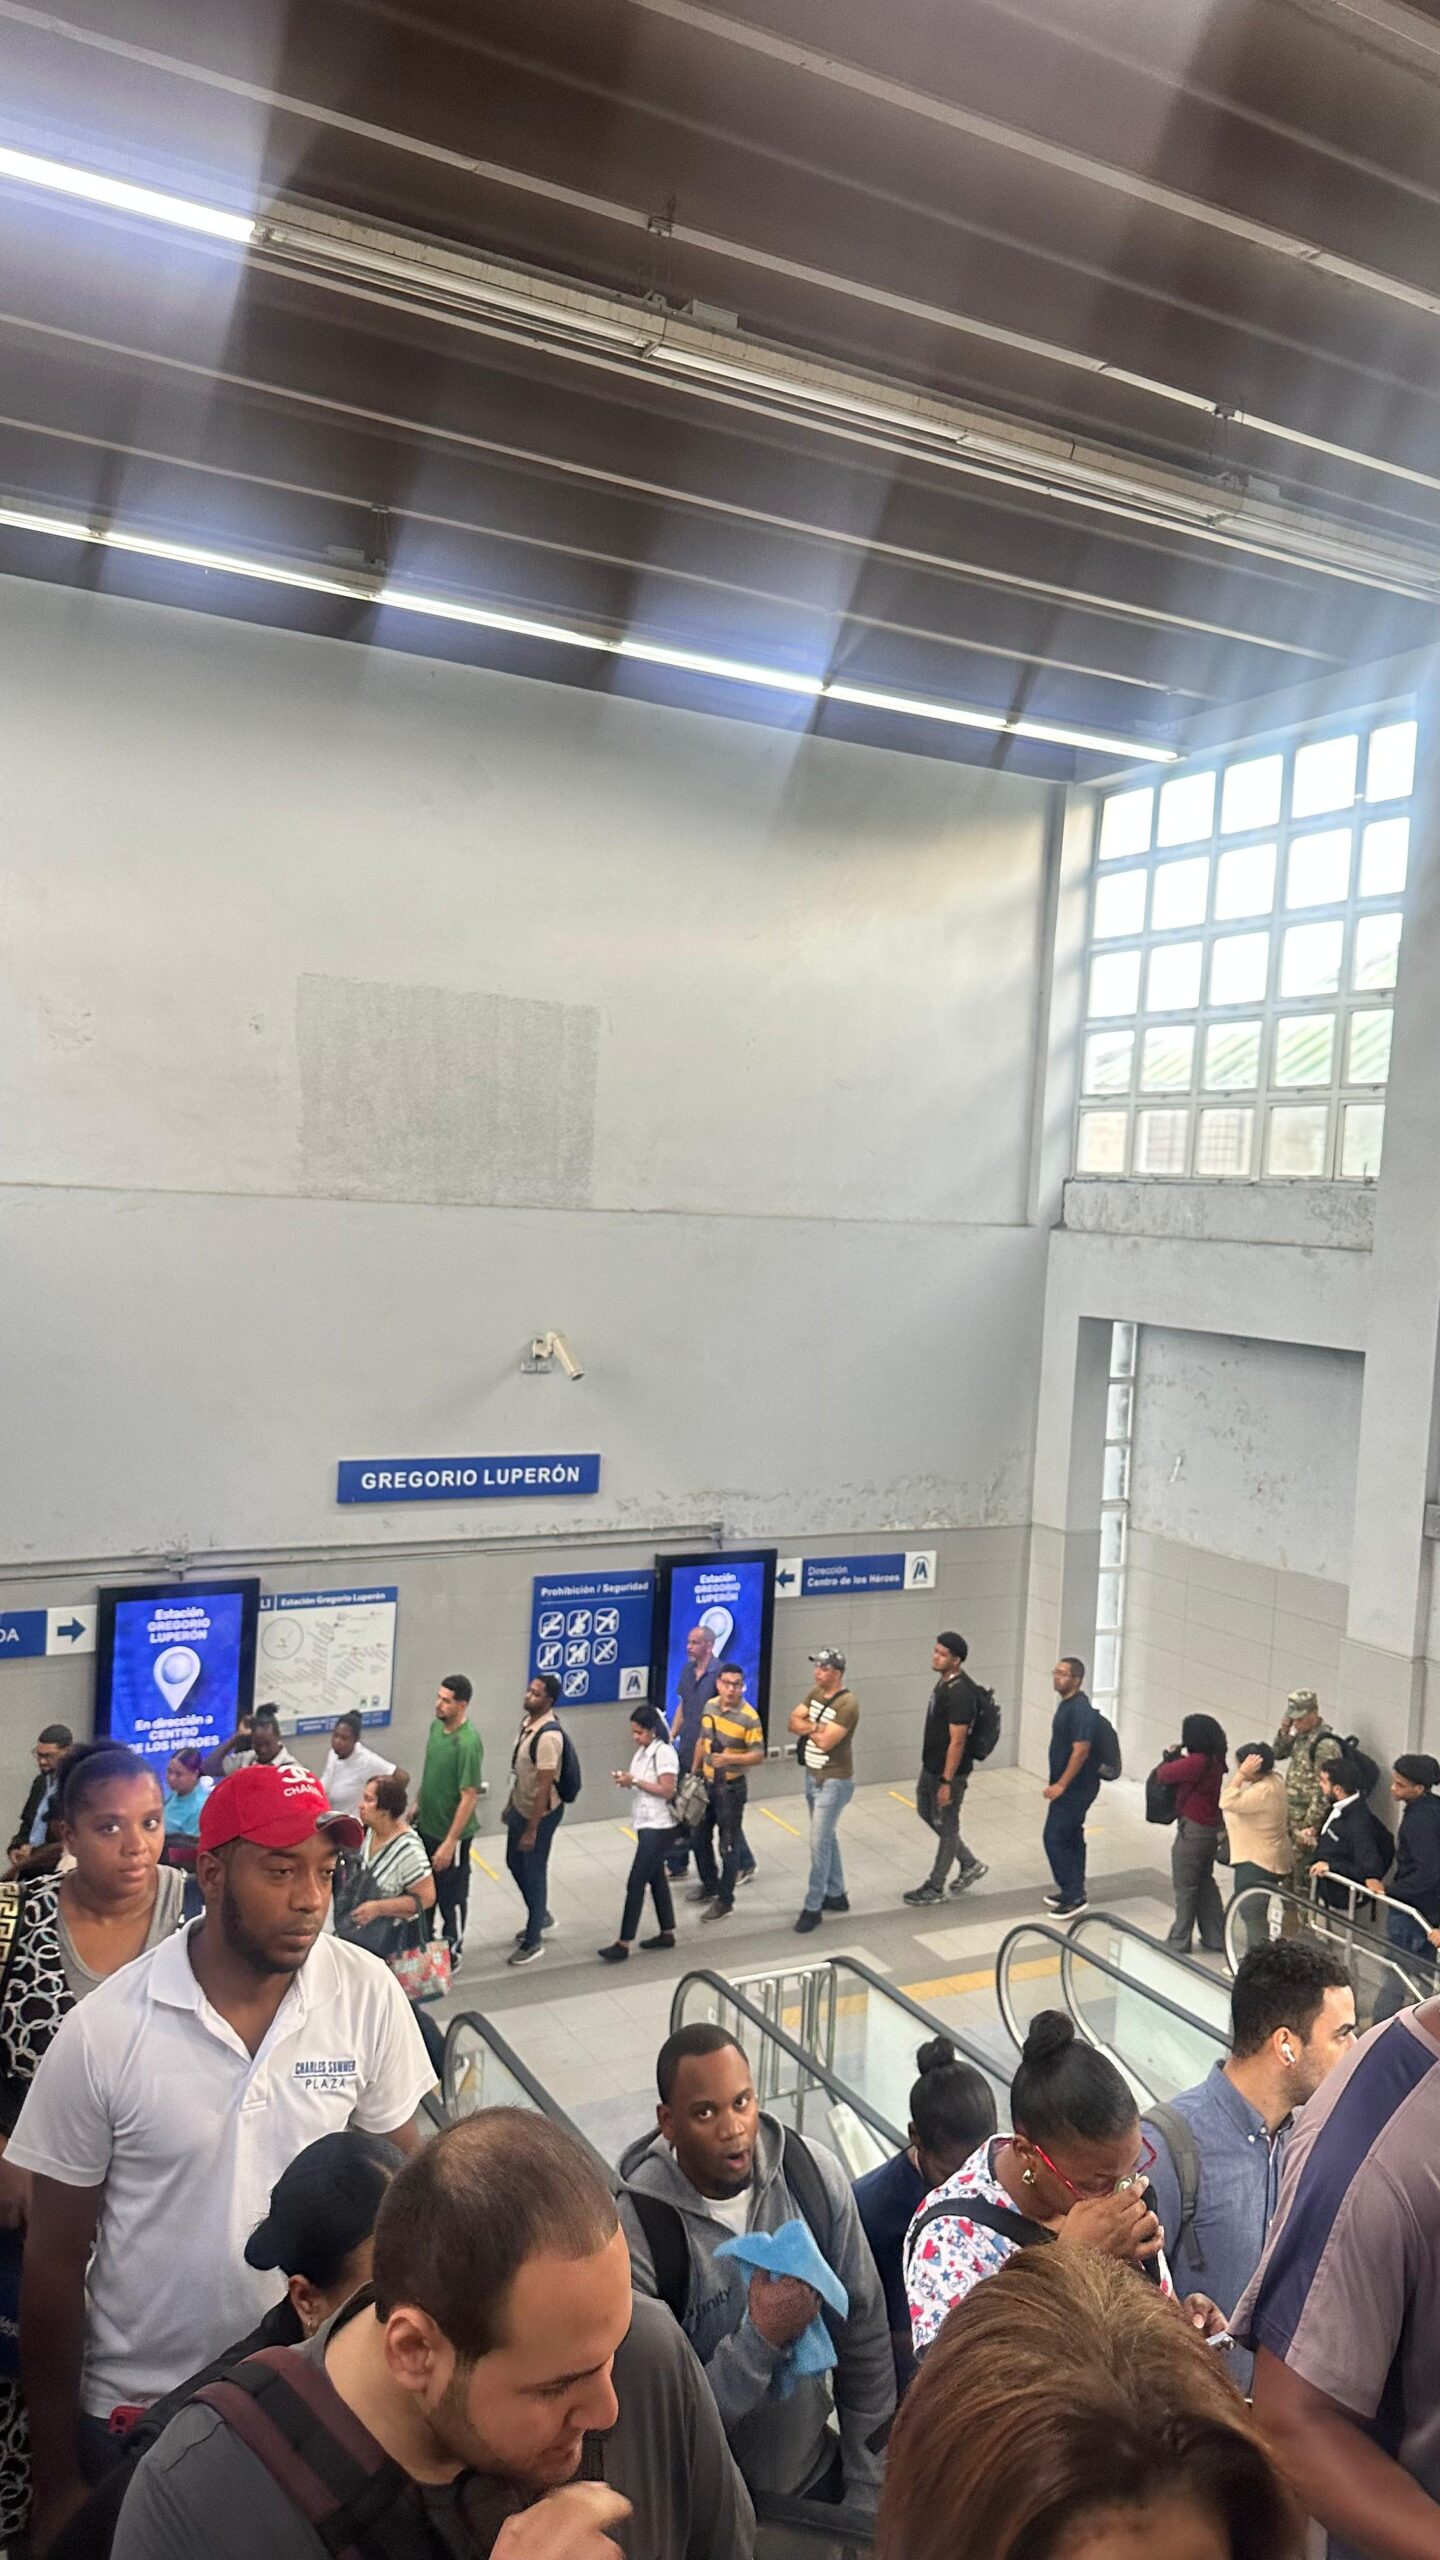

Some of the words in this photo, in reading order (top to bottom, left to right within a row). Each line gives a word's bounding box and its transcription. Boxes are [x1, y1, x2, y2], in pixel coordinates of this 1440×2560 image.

[361, 1469, 478, 1490] GREGORIO
[483, 1464, 580, 1486] LUPERÓN
[807, 1565, 848, 1576] Dirección
[807, 1577, 838, 1587] Centro
[840, 1576, 851, 1585] de
[853, 1575, 867, 1584] los
[869, 1573, 900, 1583] Héroes
[541, 1585, 595, 1597] Prohibición
[603, 1581, 649, 1594] Seguridad
[281, 1596, 315, 1606] Estación
[316, 1595, 351, 1605] Gregorio
[147, 1617, 211, 1632] GREGORIO
[145, 1740, 170, 1753] LOS
[295, 2061, 326, 2075] CHARLES
[305, 2078, 345, 2089] PLAZA
